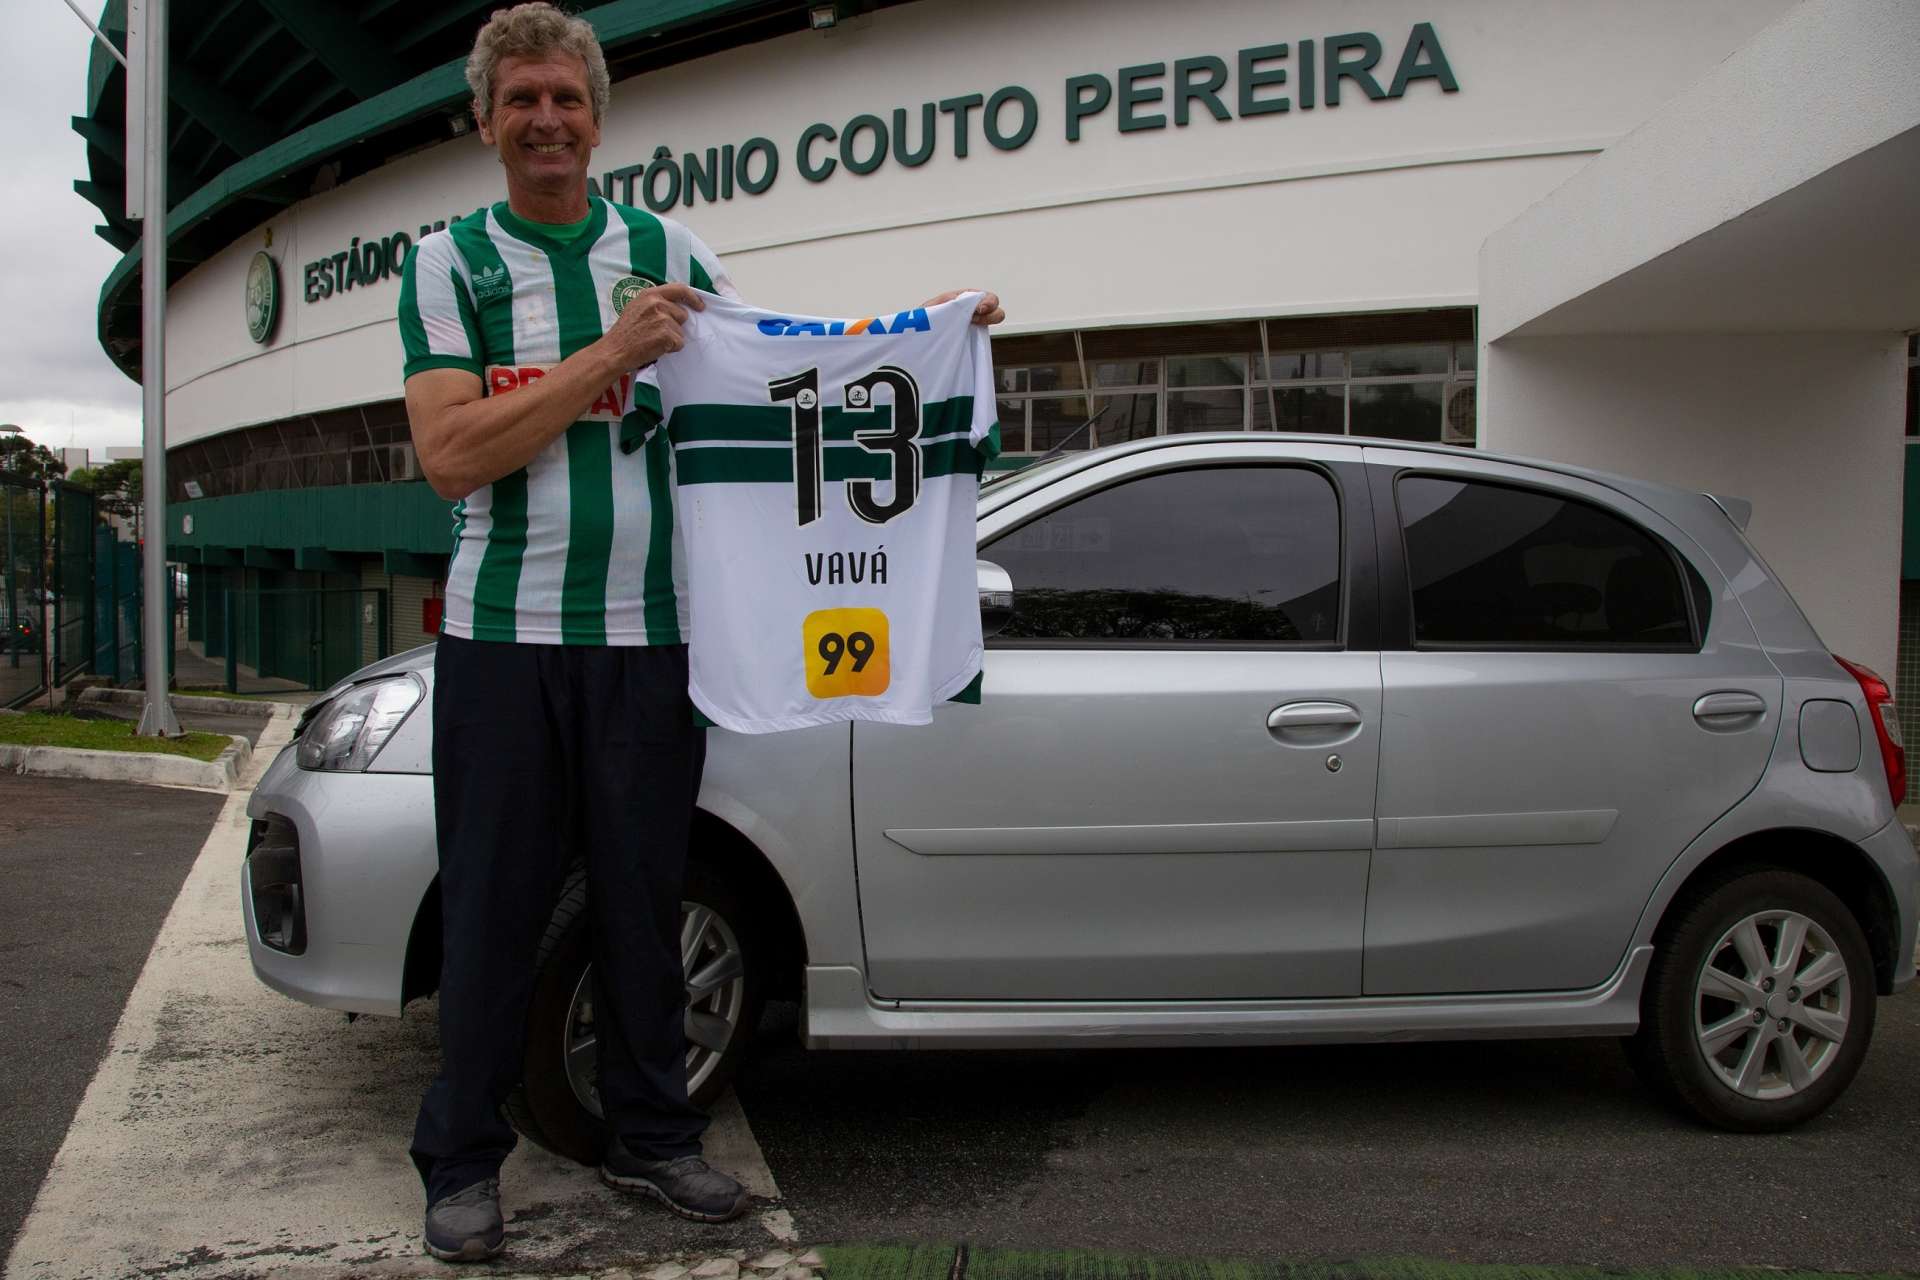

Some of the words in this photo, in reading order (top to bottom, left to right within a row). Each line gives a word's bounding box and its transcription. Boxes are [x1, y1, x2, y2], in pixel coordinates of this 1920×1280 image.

[304, 232, 412, 304] ESTÁDIO
[587, 136, 780, 213] NTÔNIO
[798, 85, 1039, 182] COUTO
[1066, 22, 1460, 141] PEREIRA
[767, 364, 924, 527] 13
[804, 545, 888, 585] VAVÁ
[818, 631, 875, 676] 99
